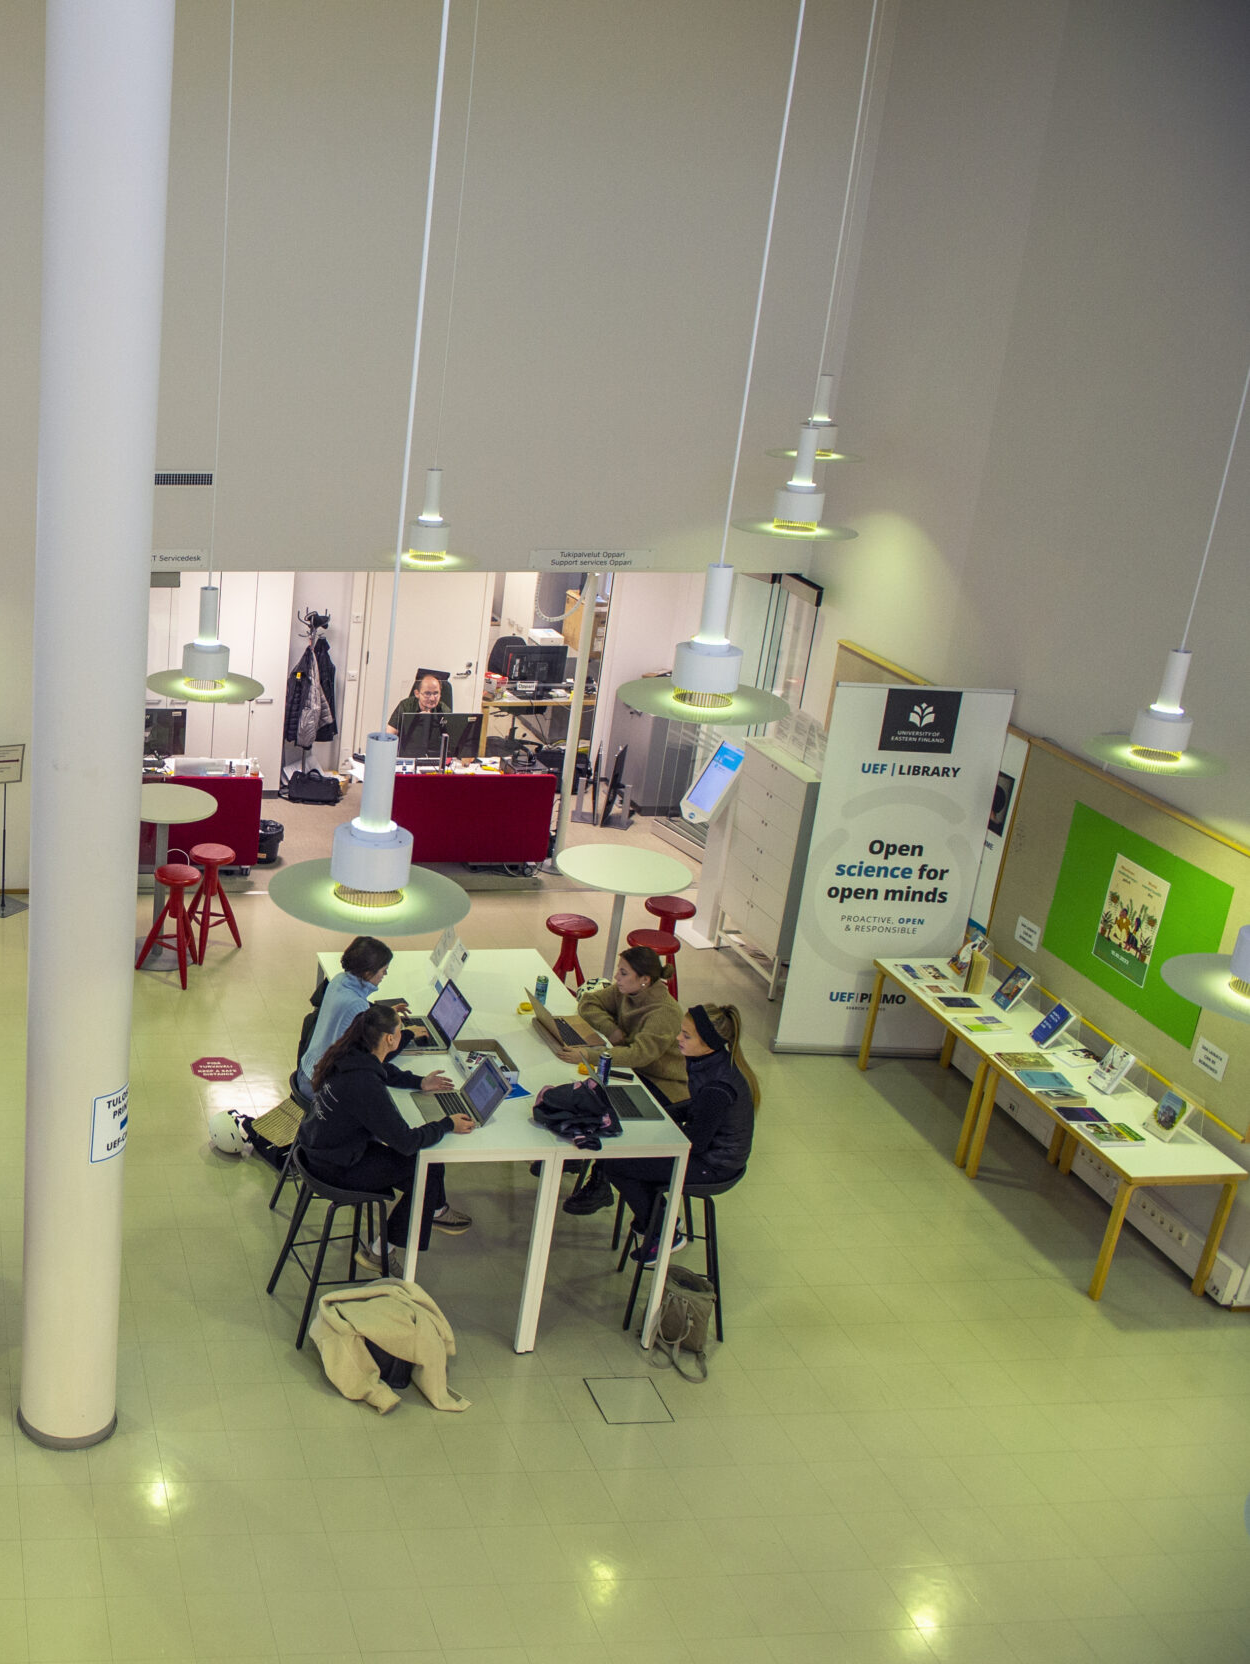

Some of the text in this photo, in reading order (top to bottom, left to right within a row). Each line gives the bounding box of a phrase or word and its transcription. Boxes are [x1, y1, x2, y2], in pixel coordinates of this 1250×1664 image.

[862, 762, 888, 774] UEF
[898, 764, 961, 778] LIBRARY
[868, 840, 924, 860] Open
[835, 860, 949, 880] science for
[827, 886, 948, 903] open minds
[841, 915, 894, 924] PROACTIVE,
[855, 925, 917, 934] RESPONSIBLE
